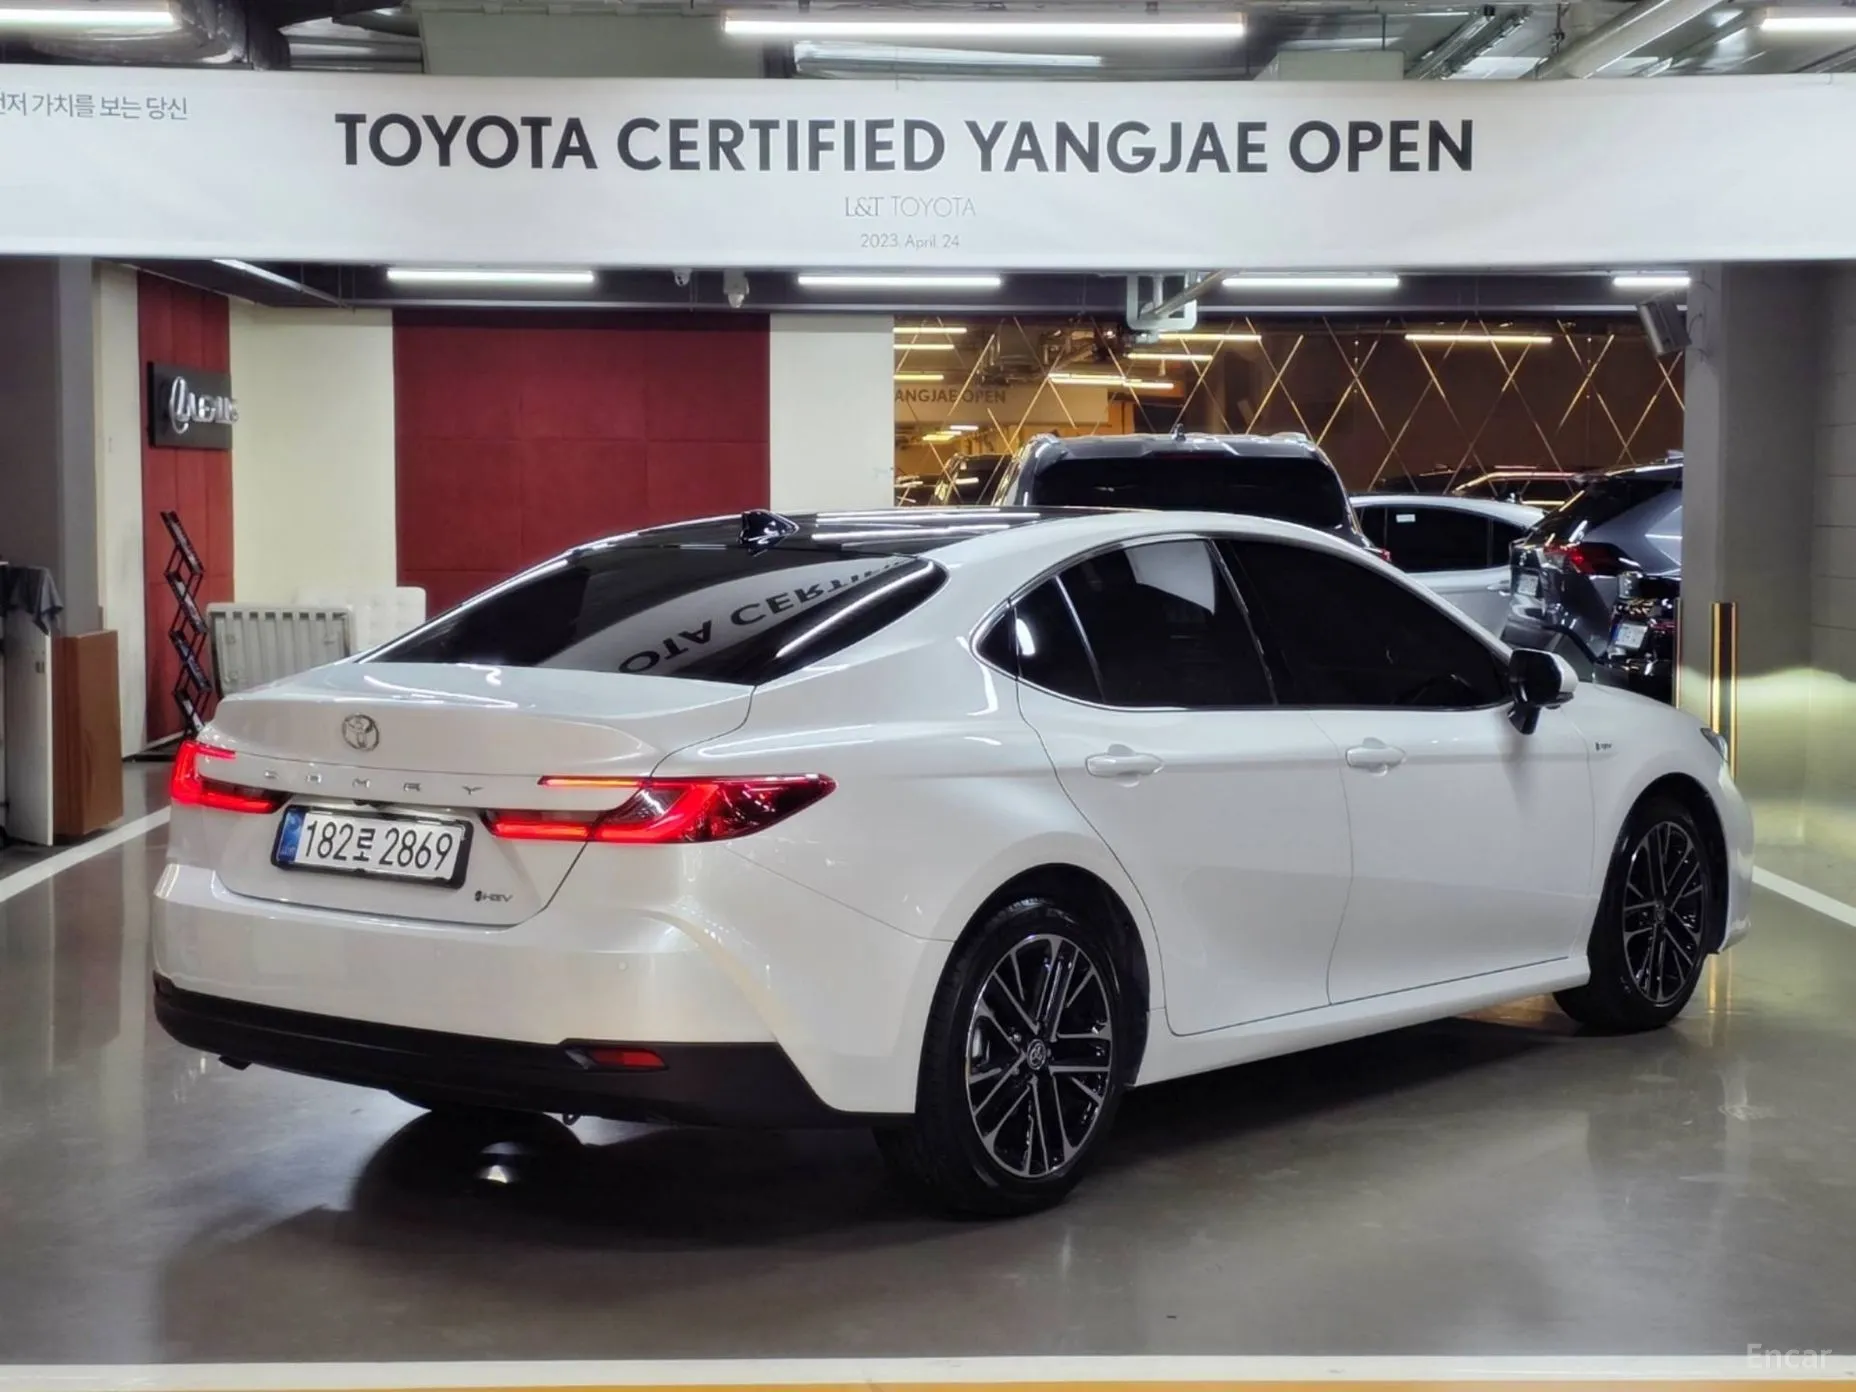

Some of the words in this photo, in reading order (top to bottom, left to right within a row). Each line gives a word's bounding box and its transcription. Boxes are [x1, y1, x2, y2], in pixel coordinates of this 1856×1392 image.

[32, 93, 95, 118] 가치를
[100, 97, 141, 119] 보는
[146, 97, 188, 120] 당신
[335, 113, 598, 169] TOYOTA
[617, 117, 946, 172] CERTIFIED
[964, 120, 1268, 173] YANGJAE
[1289, 119, 1473, 173] OPEN
[845, 196, 885, 217] L&T
[890, 195, 976, 218] TOYOTA
[942, 233, 960, 248] 24
[378, 827, 453, 871] 2869
